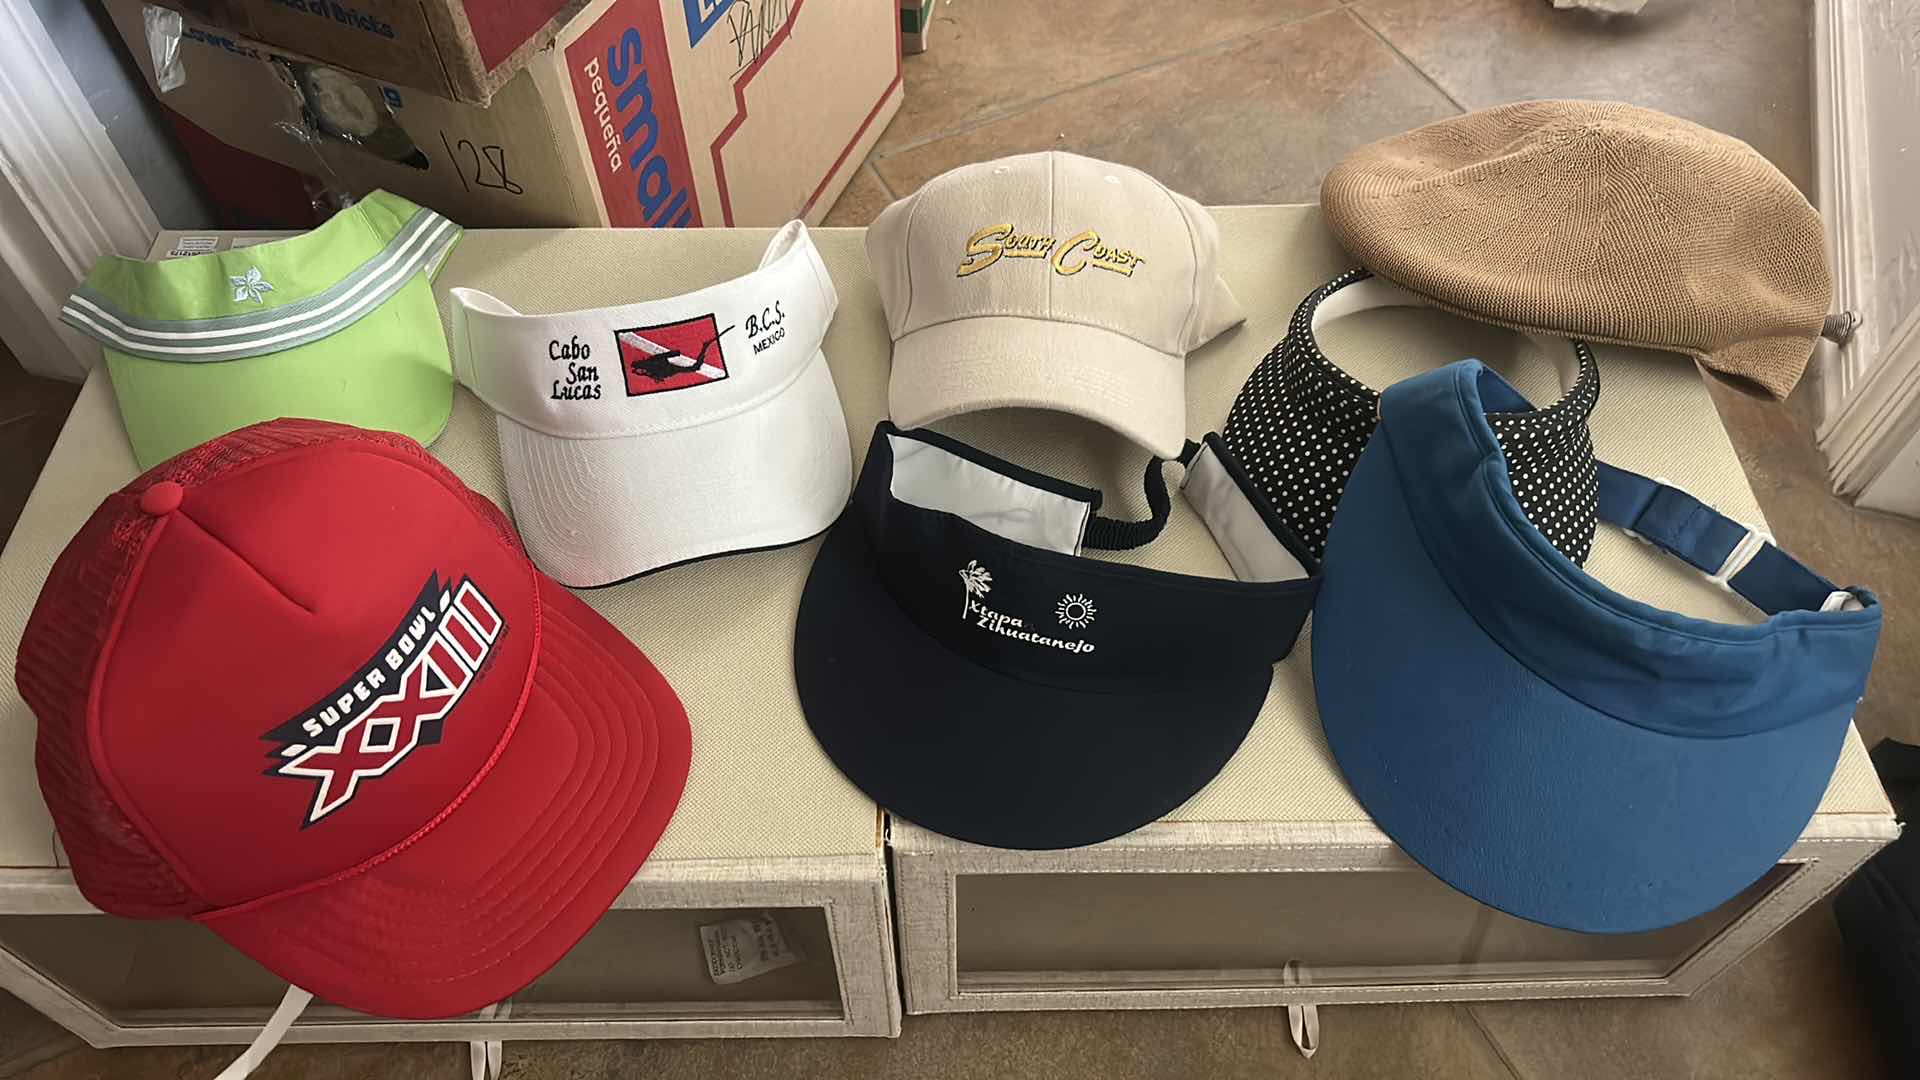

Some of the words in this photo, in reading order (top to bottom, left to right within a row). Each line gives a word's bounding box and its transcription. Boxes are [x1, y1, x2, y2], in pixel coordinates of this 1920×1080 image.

[584, 56, 623, 174] pequeña
[440, 129, 523, 194] 128
[745, 300, 785, 339] B.C.S.
[549, 336, 590, 361] Cabo
[753, 327, 785, 355] MEXICO
[551, 380, 601, 400] Lucas
[566, 362, 599, 385] San
[977, 614, 1095, 653] Zihuatanejo
[302, 667, 386, 738] SUPER
[385, 606, 436, 670] BOWL
[278, 580, 502, 823] XXIII
